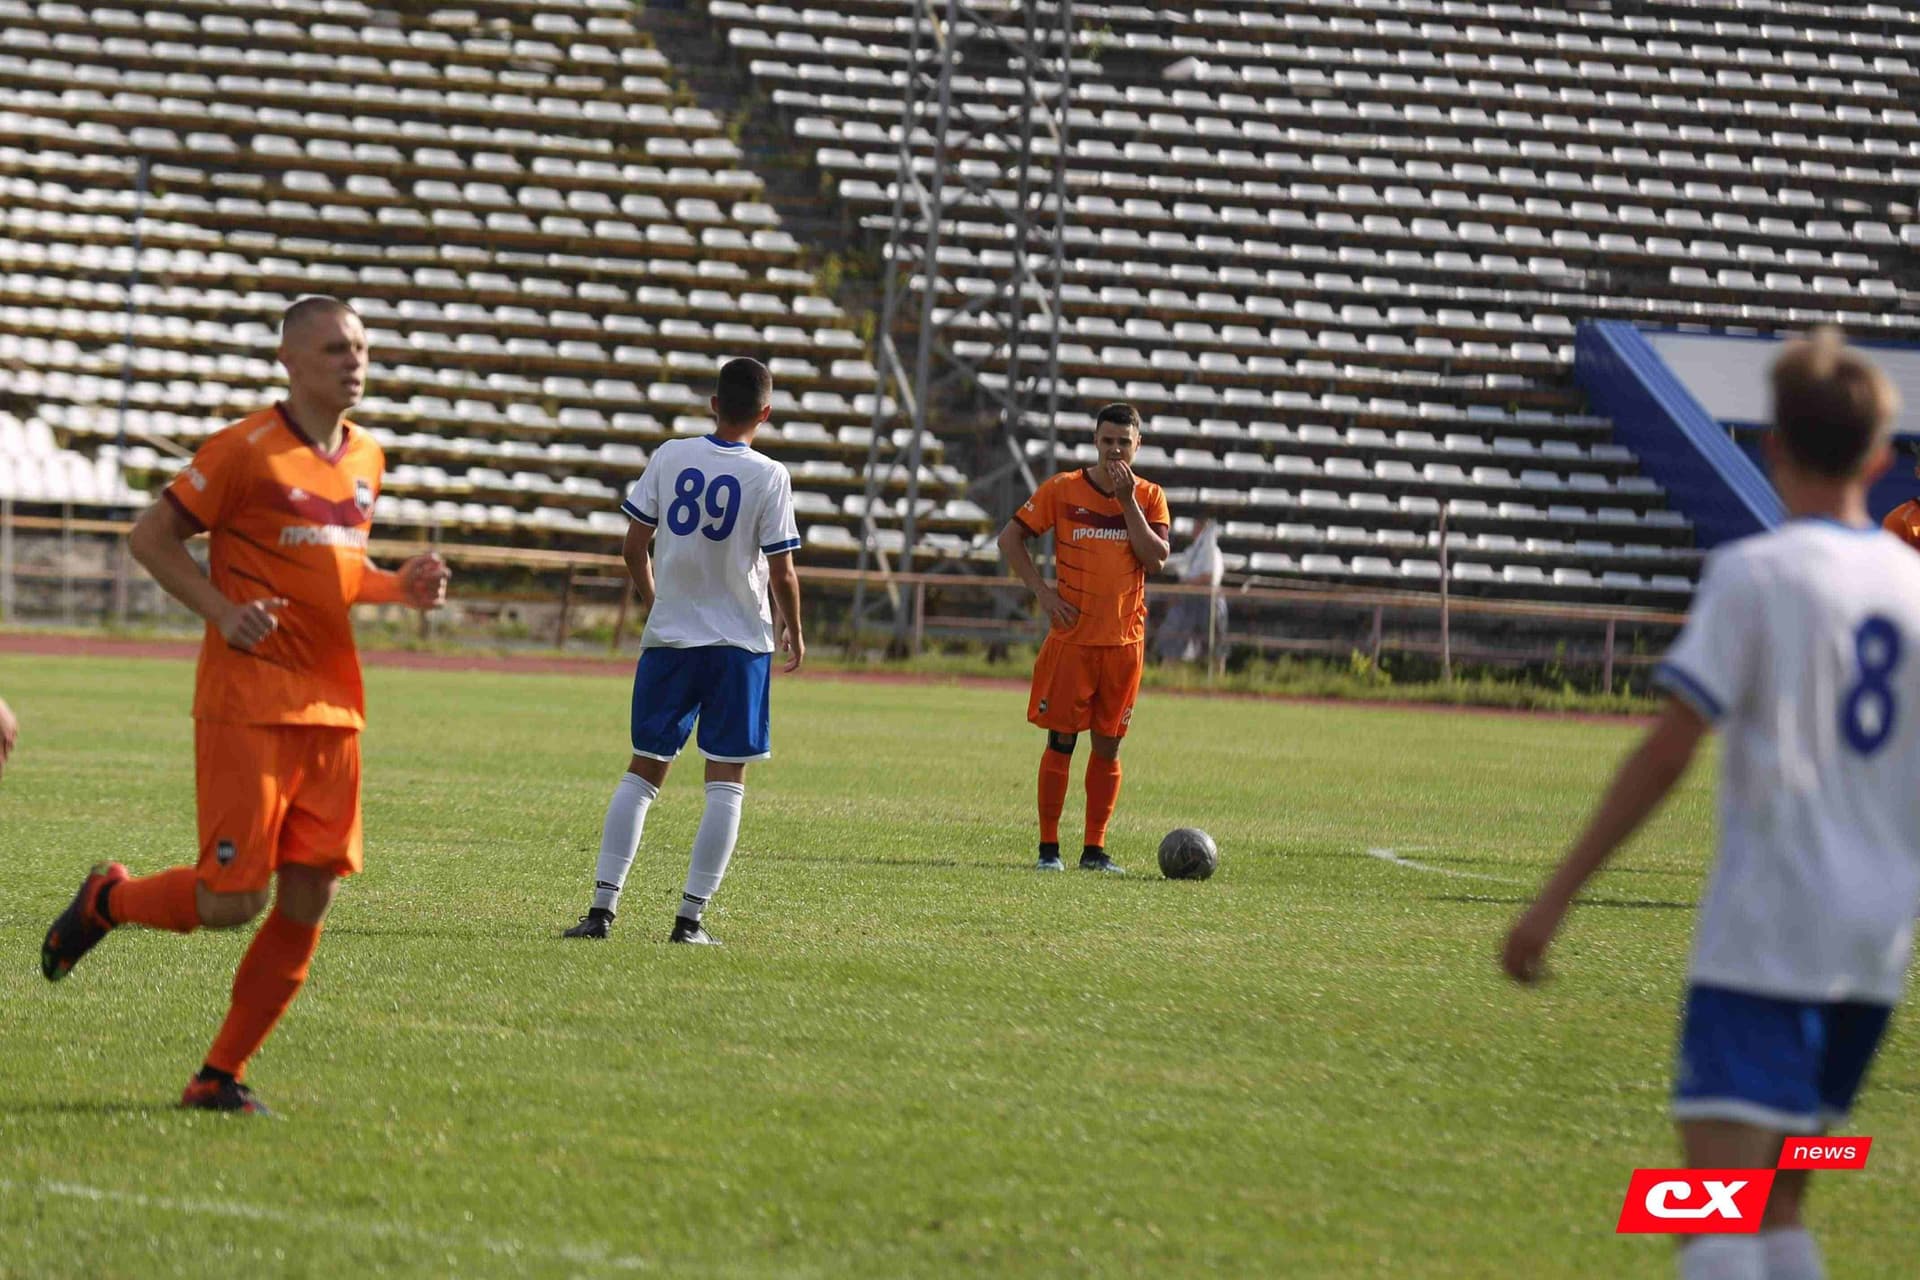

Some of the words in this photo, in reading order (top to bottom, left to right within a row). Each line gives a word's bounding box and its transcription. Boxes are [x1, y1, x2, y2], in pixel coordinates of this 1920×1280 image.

[666, 467, 742, 542] 89
[1072, 527, 1129, 541] ПРОДИНВ
[1840, 613, 1902, 756] 8
